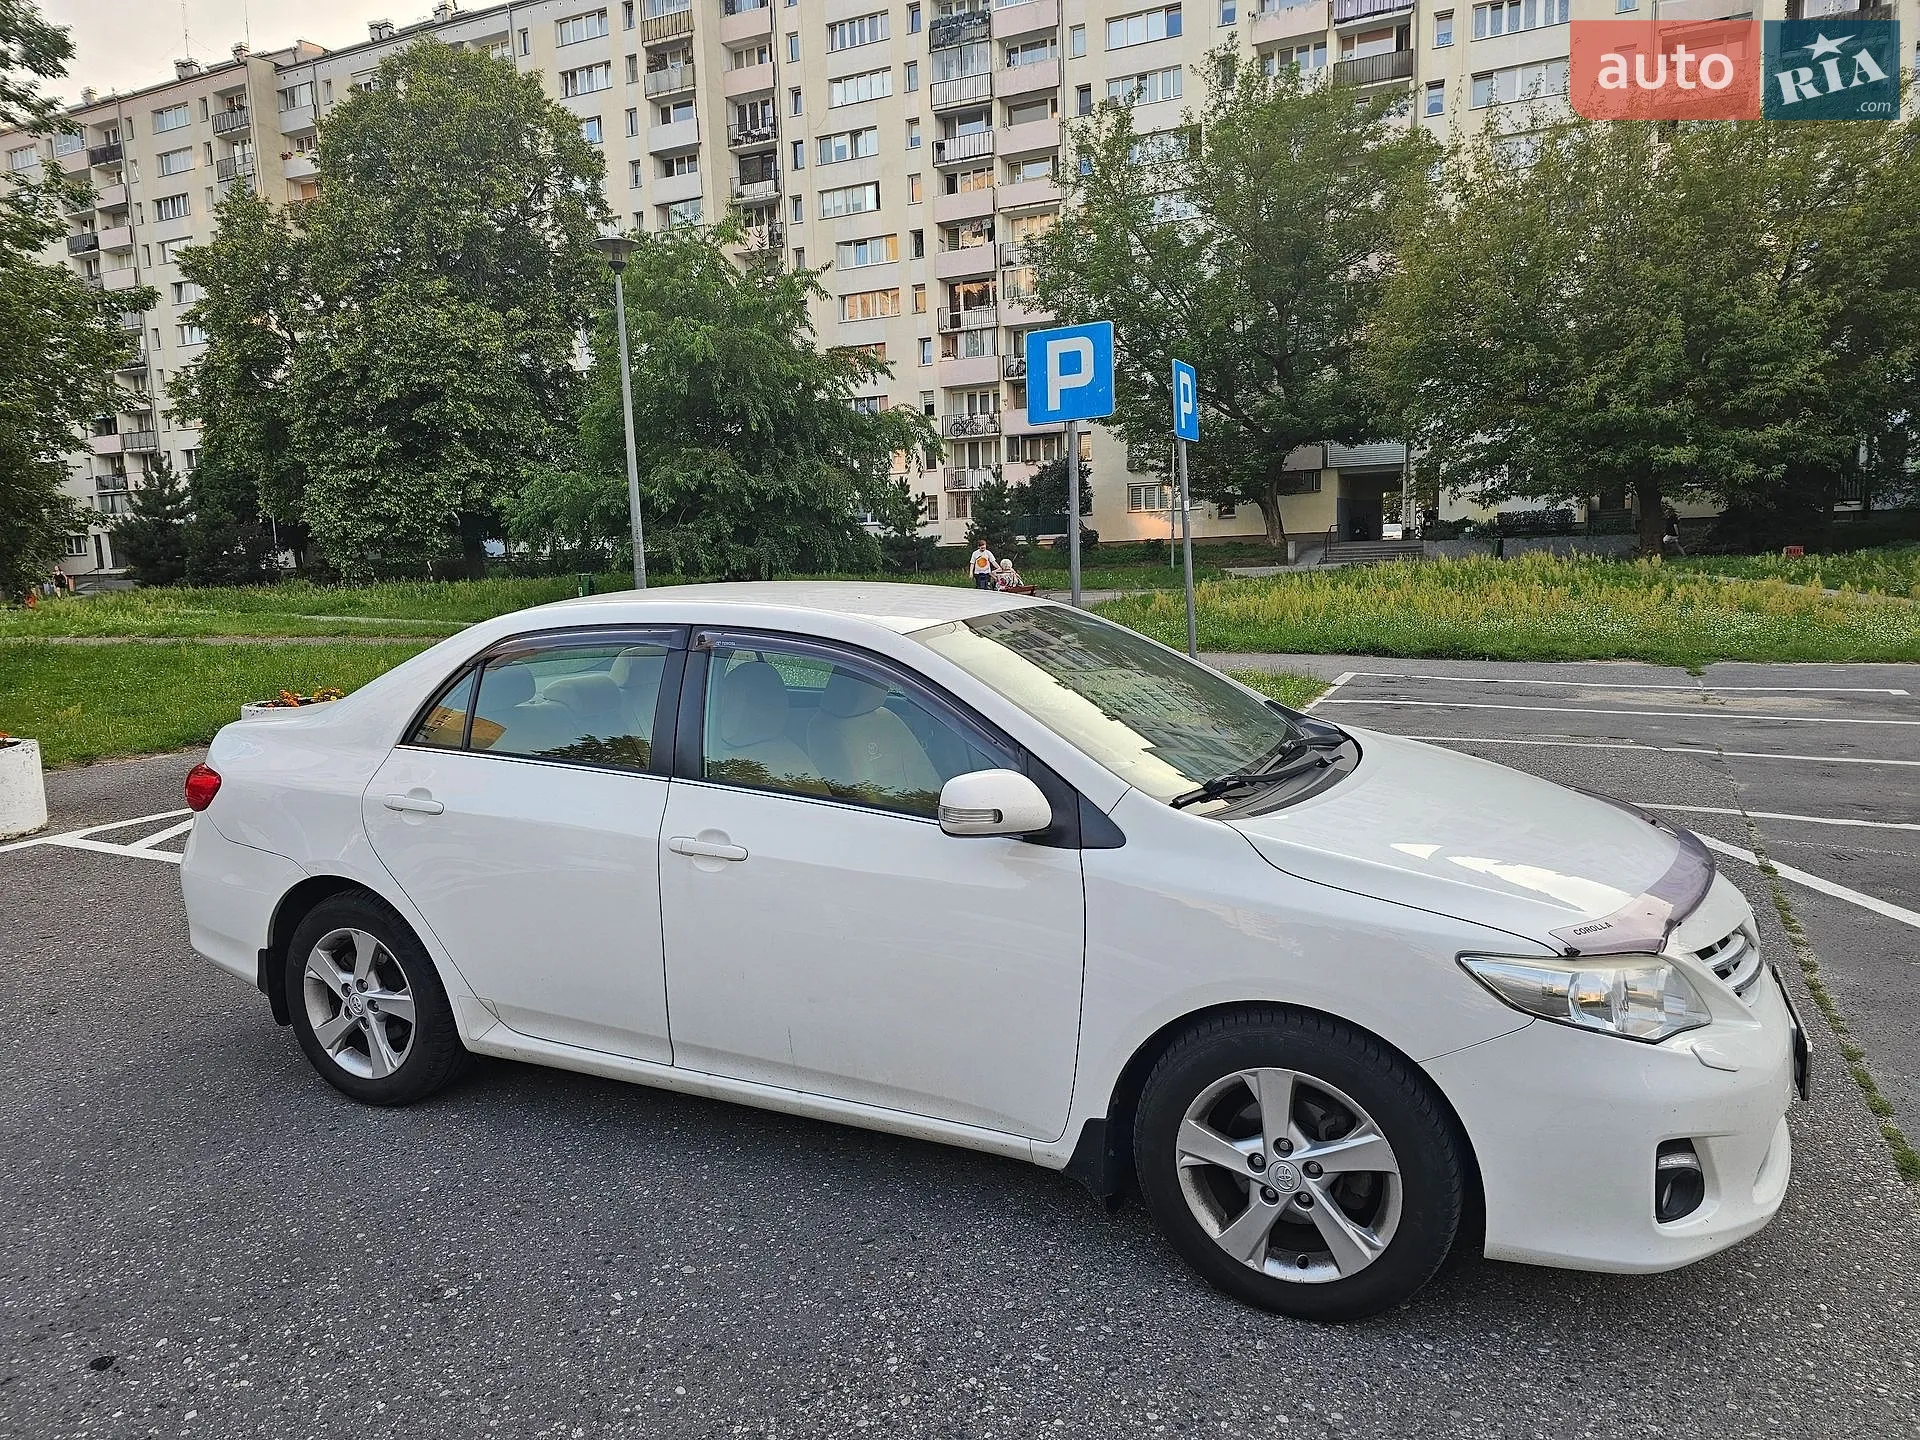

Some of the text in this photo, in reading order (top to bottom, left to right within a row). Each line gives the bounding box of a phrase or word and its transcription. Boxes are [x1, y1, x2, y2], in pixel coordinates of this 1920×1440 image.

[1046, 336, 1094, 411] P
[1179, 370, 1193, 429] P
[1573, 921, 1613, 935] COROLLA
